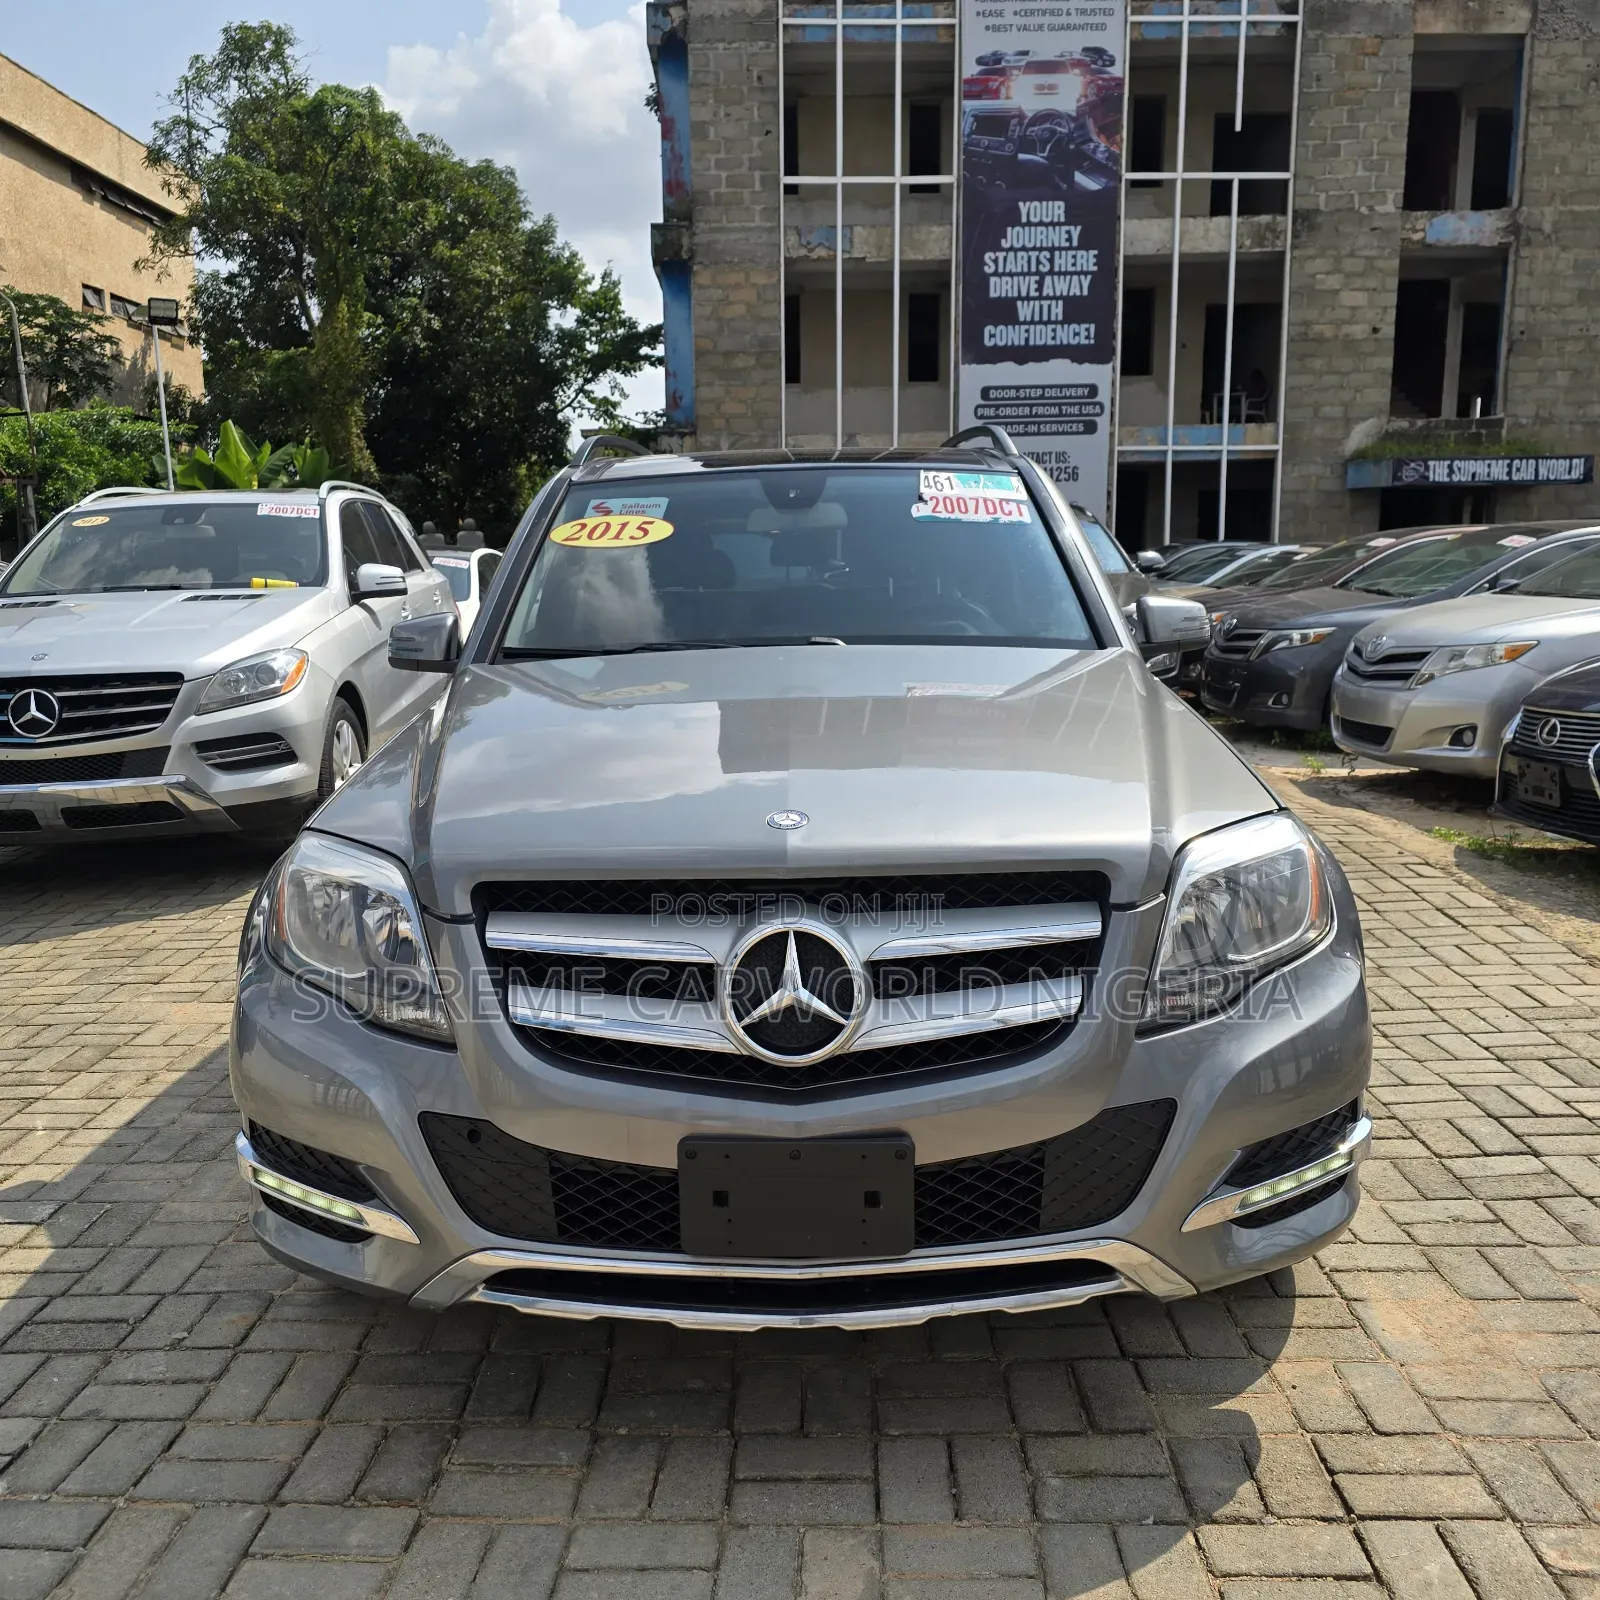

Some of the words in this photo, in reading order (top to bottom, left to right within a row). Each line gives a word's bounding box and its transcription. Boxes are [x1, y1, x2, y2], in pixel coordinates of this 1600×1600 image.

[982, 9, 1005, 17] EASE
[1018, 8, 1063, 17] CERTIFIED
[1066, 8, 1072, 17] &
[1075, 8, 1114, 17] TRUSTED
[991, 24, 1014, 32] BEST
[1016, 23, 1045, 32] VALUE
[1047, 23, 1107, 32] GUARANTEED
[1018, 201, 1065, 223] YOUR
[1000, 226, 1082, 248] JOURNEY
[984, 251, 1050, 273] STARTS
[1054, 250, 1098, 272] HERE
[989, 276, 1040, 298] DRIVE
[1042, 275, 1092, 297] AWAY
[1016, 300, 1063, 321] WITH
[984, 323, 1095, 346] CONFIDENCE!
[989, 388, 1043, 398] DOOR-STEP
[1045, 387, 1089, 397] DELIVERY
[977, 406, 1030, 416] PRE-ORDER
[1032, 406, 1059, 415] FROM
[1061, 405, 1080, 415] THE
[1082, 405, 1101, 414] USA
[1001, 424, 1038, 434] RADE-IN
[1040, 423, 1084, 433] SERVICES
[1055, 451, 1071, 464] US:
[1427, 460, 1451, 482] THE
[1453, 459, 1510, 482] SUPREME
[1512, 459, 1537, 481] CAR
[1538, 458, 1585, 480] WORLD!
[268, 506, 318, 516] 2007DCT
[561, 520, 656, 542] 2015
